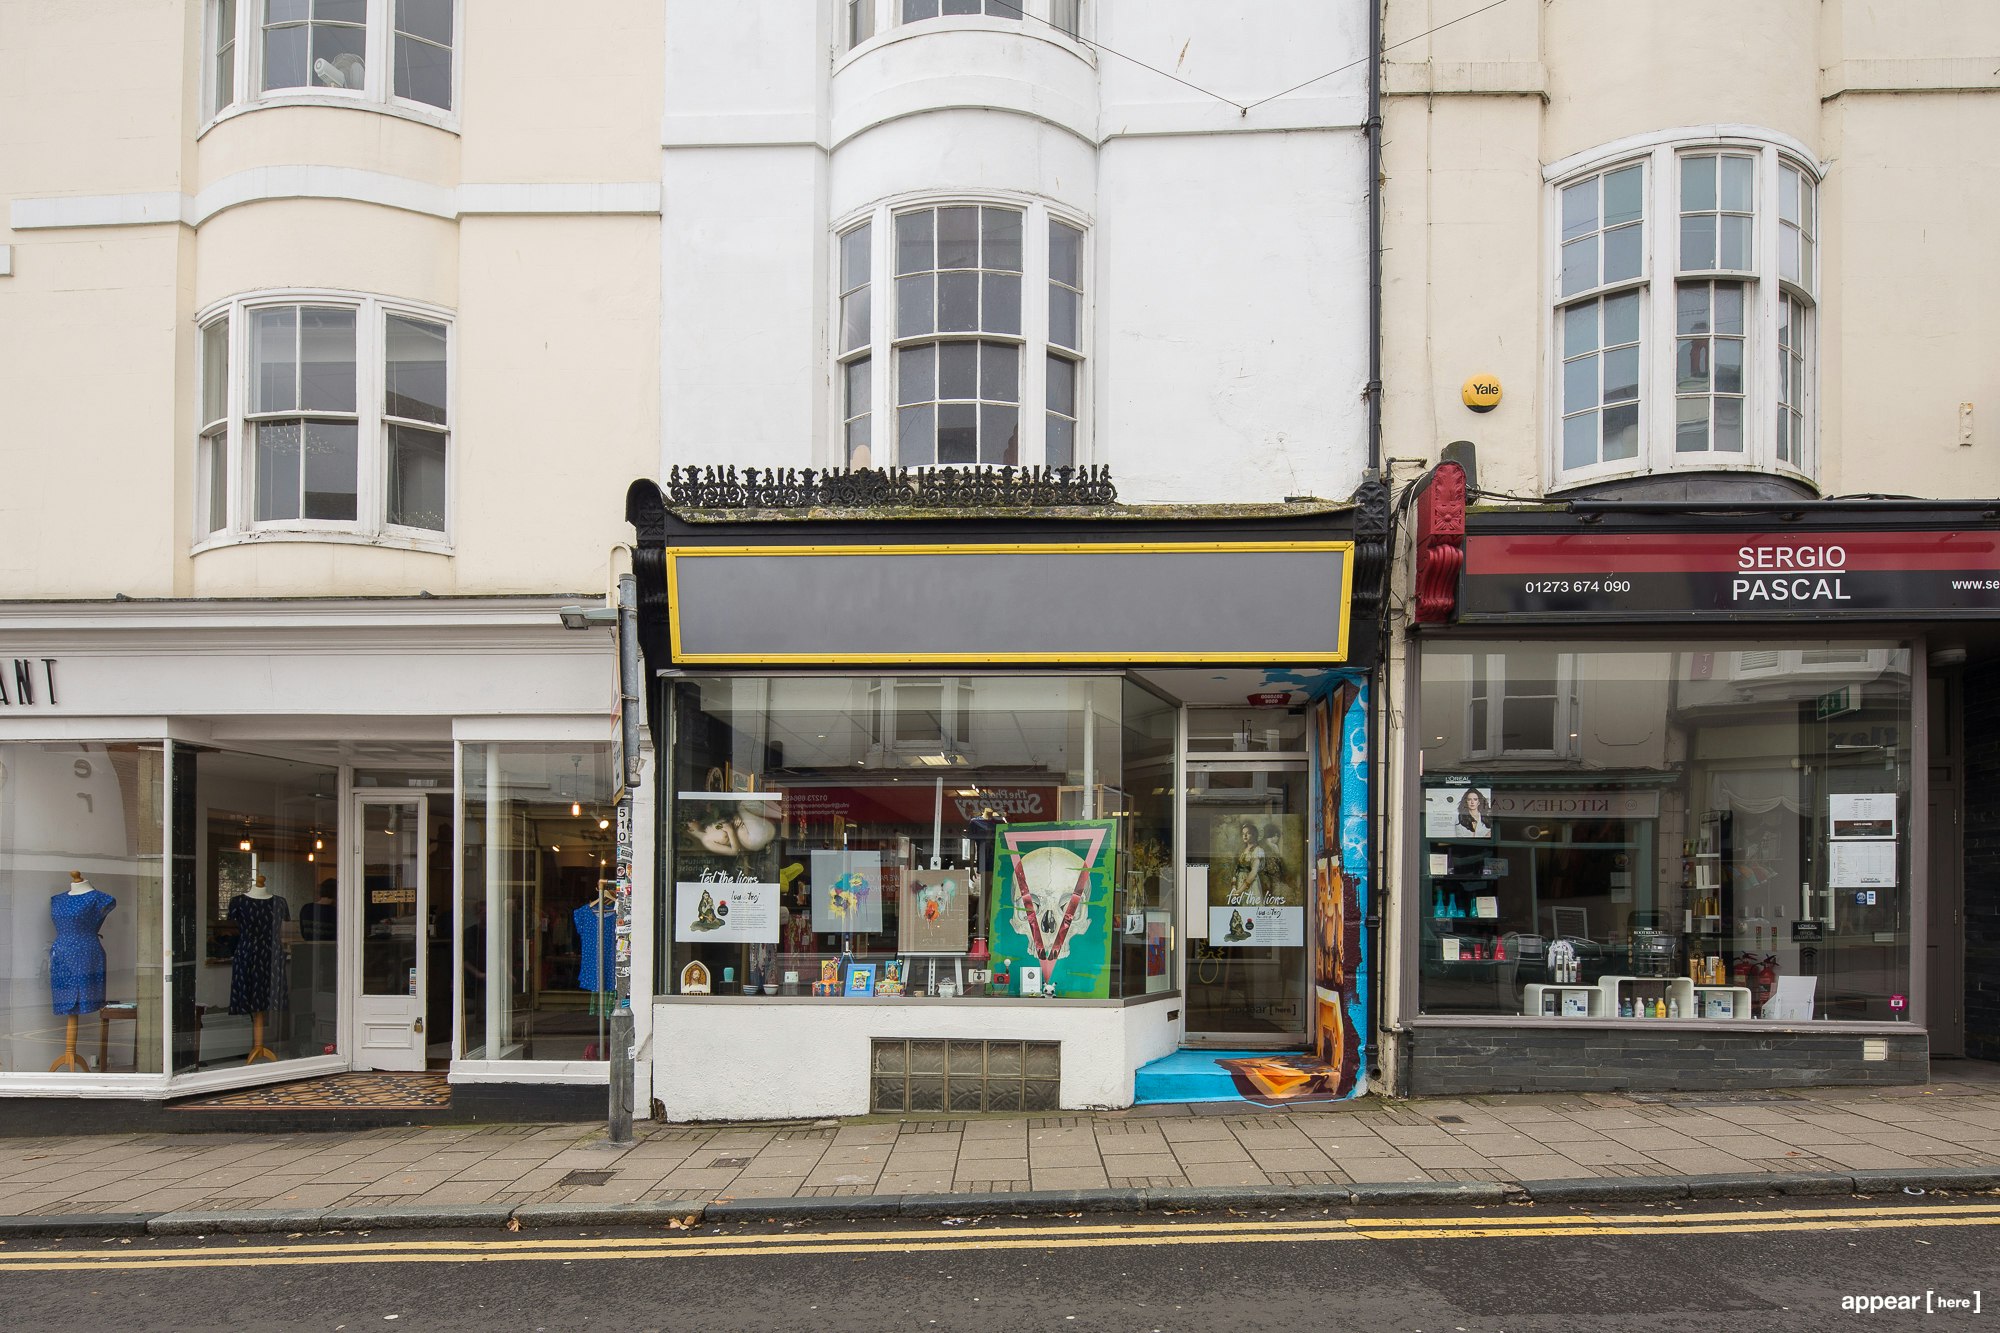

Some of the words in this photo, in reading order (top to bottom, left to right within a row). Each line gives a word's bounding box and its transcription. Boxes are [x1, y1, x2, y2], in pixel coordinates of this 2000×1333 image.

[1473, 384, 1498, 394] Yale
[1738, 545, 1846, 568] SERGIO
[1525, 581, 1570, 593] 01273
[1573, 581, 1599, 592] 674
[1604, 580, 1631, 592] 090
[1733, 578, 1851, 601] PASCAL
[1226, 887, 1244, 905] fed
[1244, 890, 1261, 905] the
[1263, 890, 1286, 905] lions
